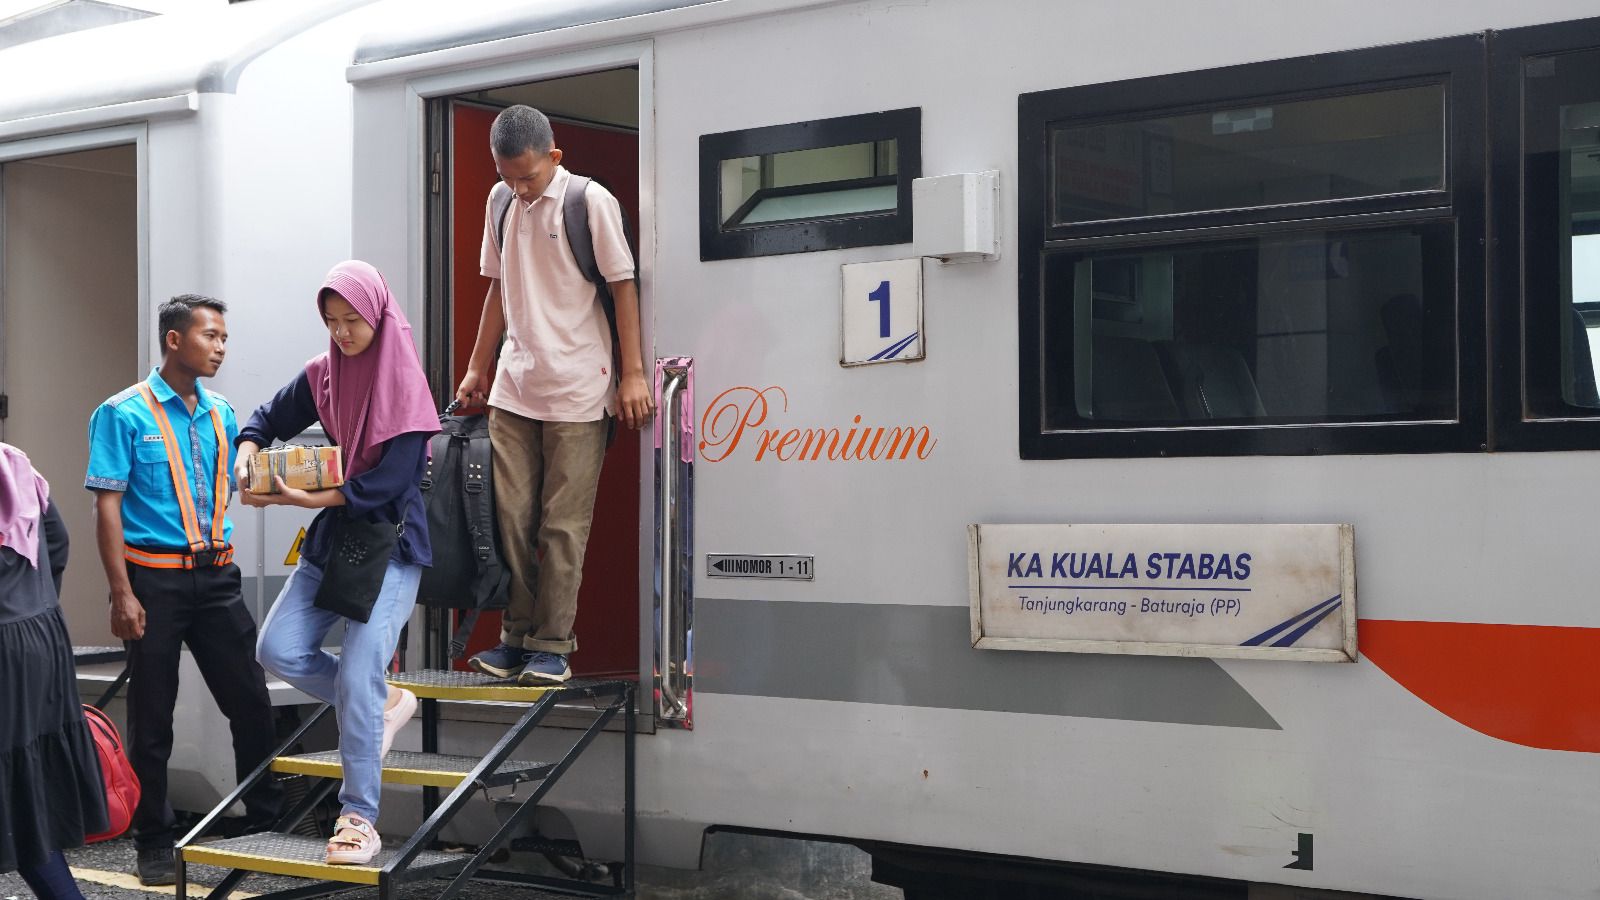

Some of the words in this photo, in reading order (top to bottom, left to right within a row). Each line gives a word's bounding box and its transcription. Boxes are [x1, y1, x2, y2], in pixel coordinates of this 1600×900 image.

[868, 280, 891, 338] 1
[698, 386, 938, 463] Premium
[735, 559, 772, 574] NOMOR
[779, 560, 784, 575] 1
[796, 560, 808, 575] 11
[1007, 552, 1044, 578] KA
[1050, 552, 1139, 579] KUALA
[1145, 552, 1252, 580] STABAS
[1018, 596, 1127, 615] Tanjungkarang
[1140, 597, 1205, 617] Baturaja
[1210, 597, 1241, 617] (PP)
